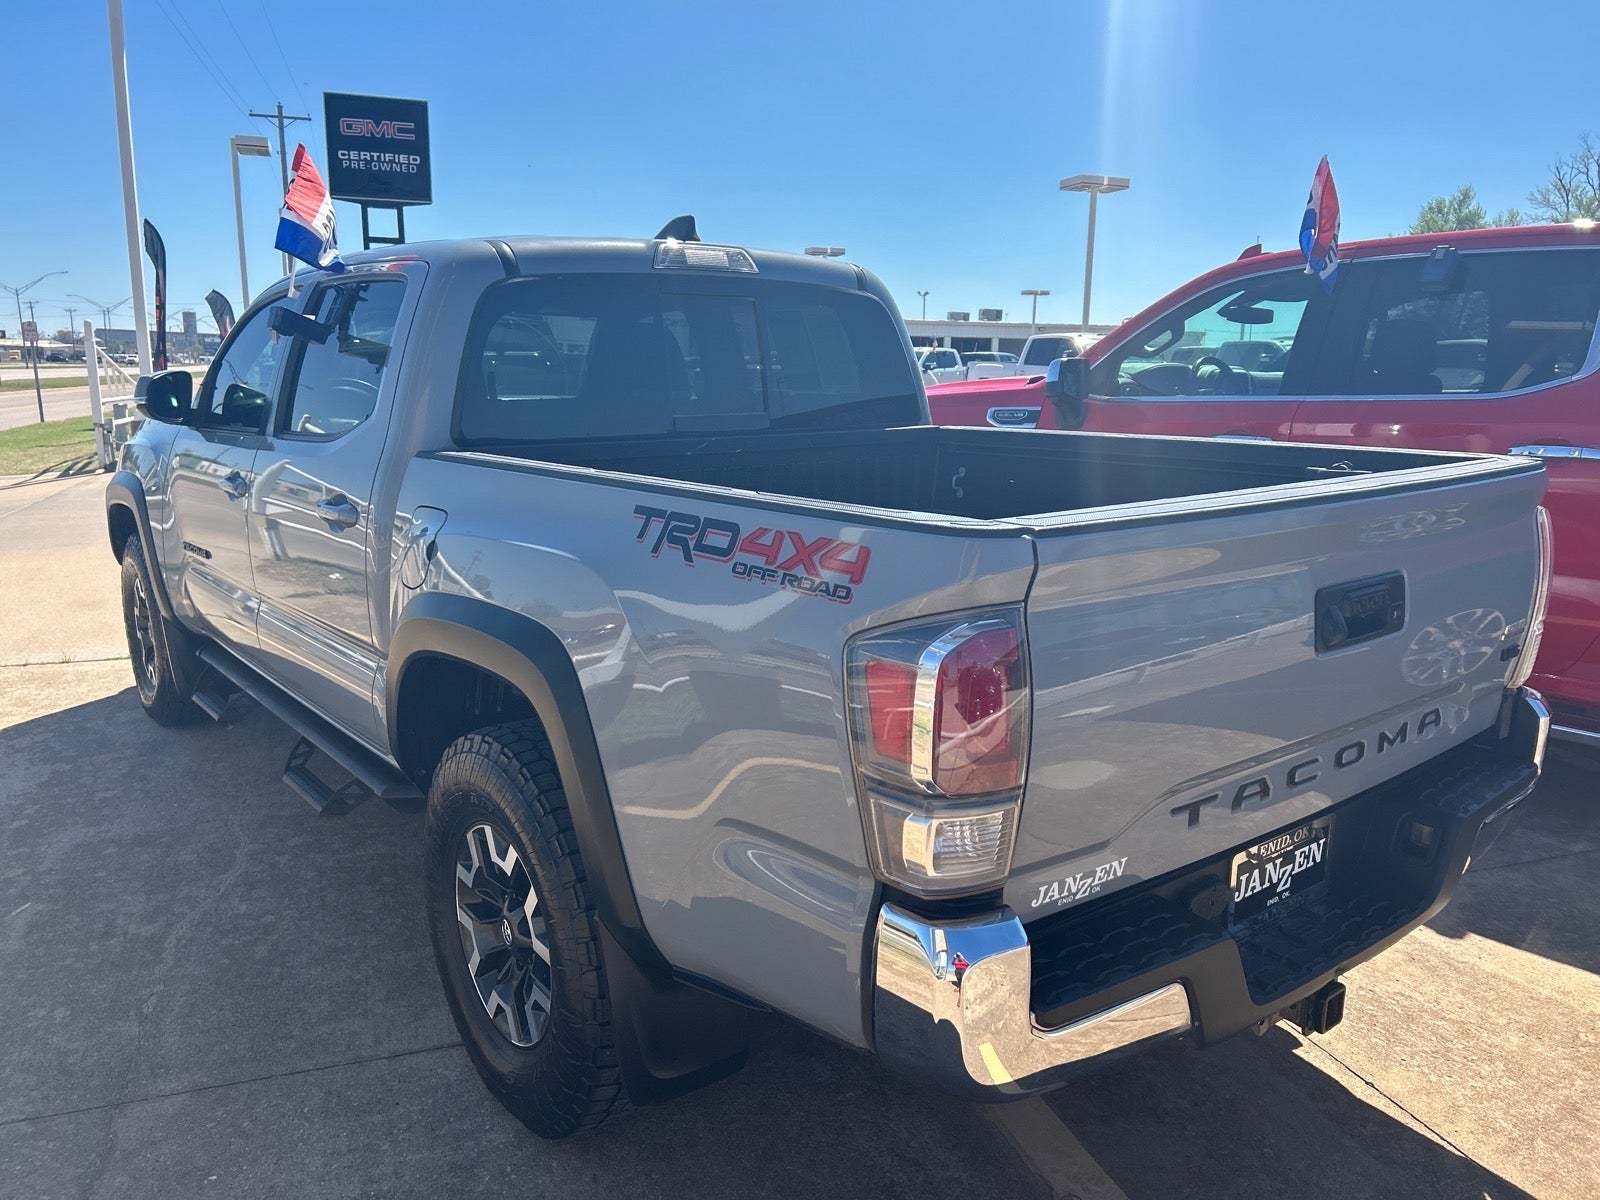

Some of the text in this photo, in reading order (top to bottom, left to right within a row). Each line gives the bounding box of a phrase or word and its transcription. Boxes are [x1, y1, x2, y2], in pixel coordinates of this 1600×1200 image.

[340, 118, 416, 140] GMC
[338, 150, 421, 165] CERTIFIED
[343, 160, 417, 173] PRE-OWNED
[633, 504, 742, 568] TRD
[731, 561, 854, 605] OFF ROAD
[1169, 706, 1443, 831] TACOMA
[1260, 825, 1311, 858] ENID, OK
[1031, 857, 1128, 907] JANZEN
[1234, 838, 1327, 903] JANZEN
